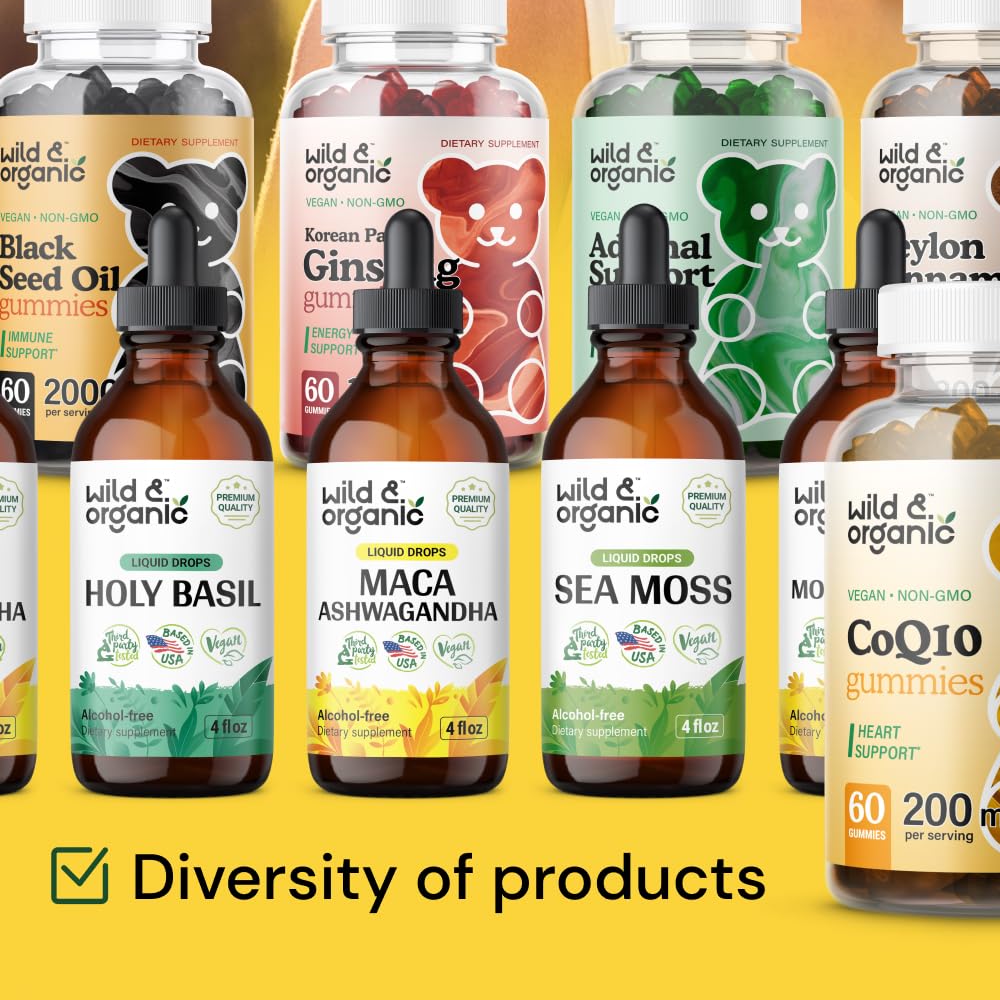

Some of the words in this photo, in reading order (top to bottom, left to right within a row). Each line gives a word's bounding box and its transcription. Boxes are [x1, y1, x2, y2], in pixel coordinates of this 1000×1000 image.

[131, 138, 178, 146] DIETARY
[181, 138, 239, 147] SUPPLEMENT
[441, 139, 484, 148] DIETARY
[488, 140, 539, 149] SUPPLEMENT
[721, 139, 767, 147] DIETARY
[771, 139, 829, 148] SUPPLEMENT
[306, 143, 346, 164] wild
[353, 143, 368, 164] &
[305, 159, 391, 191] organic
[306, 198, 337, 207] VEGAN
[347, 198, 405, 208] NON-GMO
[0, 213, 30, 222] VEGAN
[40, 213, 99, 222] NON-GMO
[305, 228, 360, 242] Korean
[0, 234, 77, 260] Black
[0, 265, 62, 291] Seed
[72, 266, 120, 291] Oil
[0, 293, 108, 321] gummies
[8, 330, 53, 343] IMMUNE
[312, 327, 353, 338] ENERGY
[304, 377, 334, 403] 60
[86, 479, 136, 502] wild
[145, 479, 163, 502] &
[322, 481, 372, 504] wild
[381, 480, 399, 504] &
[557, 478, 608, 501] wild
[616, 477, 634, 501] &
[216, 493, 255, 502] PREMIUM
[452, 495, 491, 503] PREMIUM
[687, 492, 726, 501] PREMIUM
[218, 504, 253, 512] QUALITY
[454, 505, 489, 514] QUALITY
[689, 503, 724, 511] QUALITY
[848, 493, 897, 520] wild
[906, 493, 927, 520] &
[86, 497, 188, 533] organic
[322, 498, 424, 535] organic
[556, 496, 660, 532] organic
[848, 514, 955, 555] organic
[368, 547, 404, 557] LIQUID
[407, 547, 446, 557] DROPS
[602, 553, 640, 564] LIQUID
[643, 553, 682, 563] DROPS
[132, 558, 168, 568] LIQUID
[171, 558, 210, 568] DROPS
[360, 569, 456, 596] MACA
[86, 580, 163, 607] HOLY
[173, 580, 261, 607] BASIL
[555, 575, 618, 605] SEA
[630, 575, 732, 605] MOSS
[848, 590, 886, 602] VEGAN
[897, 589, 972, 602] NON-GMO
[319, 602, 498, 621] ASHWAGANDHA
[205, 635, 242, 654] Vegan
[679, 631, 718, 652] Vegan
[847, 618, 982, 665] CoQ10
[161, 654, 184, 665] USA
[631, 652, 655, 664] USA
[846, 666, 984, 701] gummies
[81, 709, 153, 721] Alcohol-free
[318, 709, 390, 722] Alcohol-free
[552, 709, 624, 721] Alcohol-free
[317, 725, 348, 738] Dietary
[352, 727, 412, 738] supplement
[552, 725, 583, 737] Dietary
[586, 726, 647, 738] supplement
[858, 724, 901, 740] HEART
[848, 792, 885, 824] 60
[903, 792, 973, 826] 200
[848, 828, 886, 841] GUMMIES
[905, 831, 924, 843] per
[927, 829, 974, 844] serving
